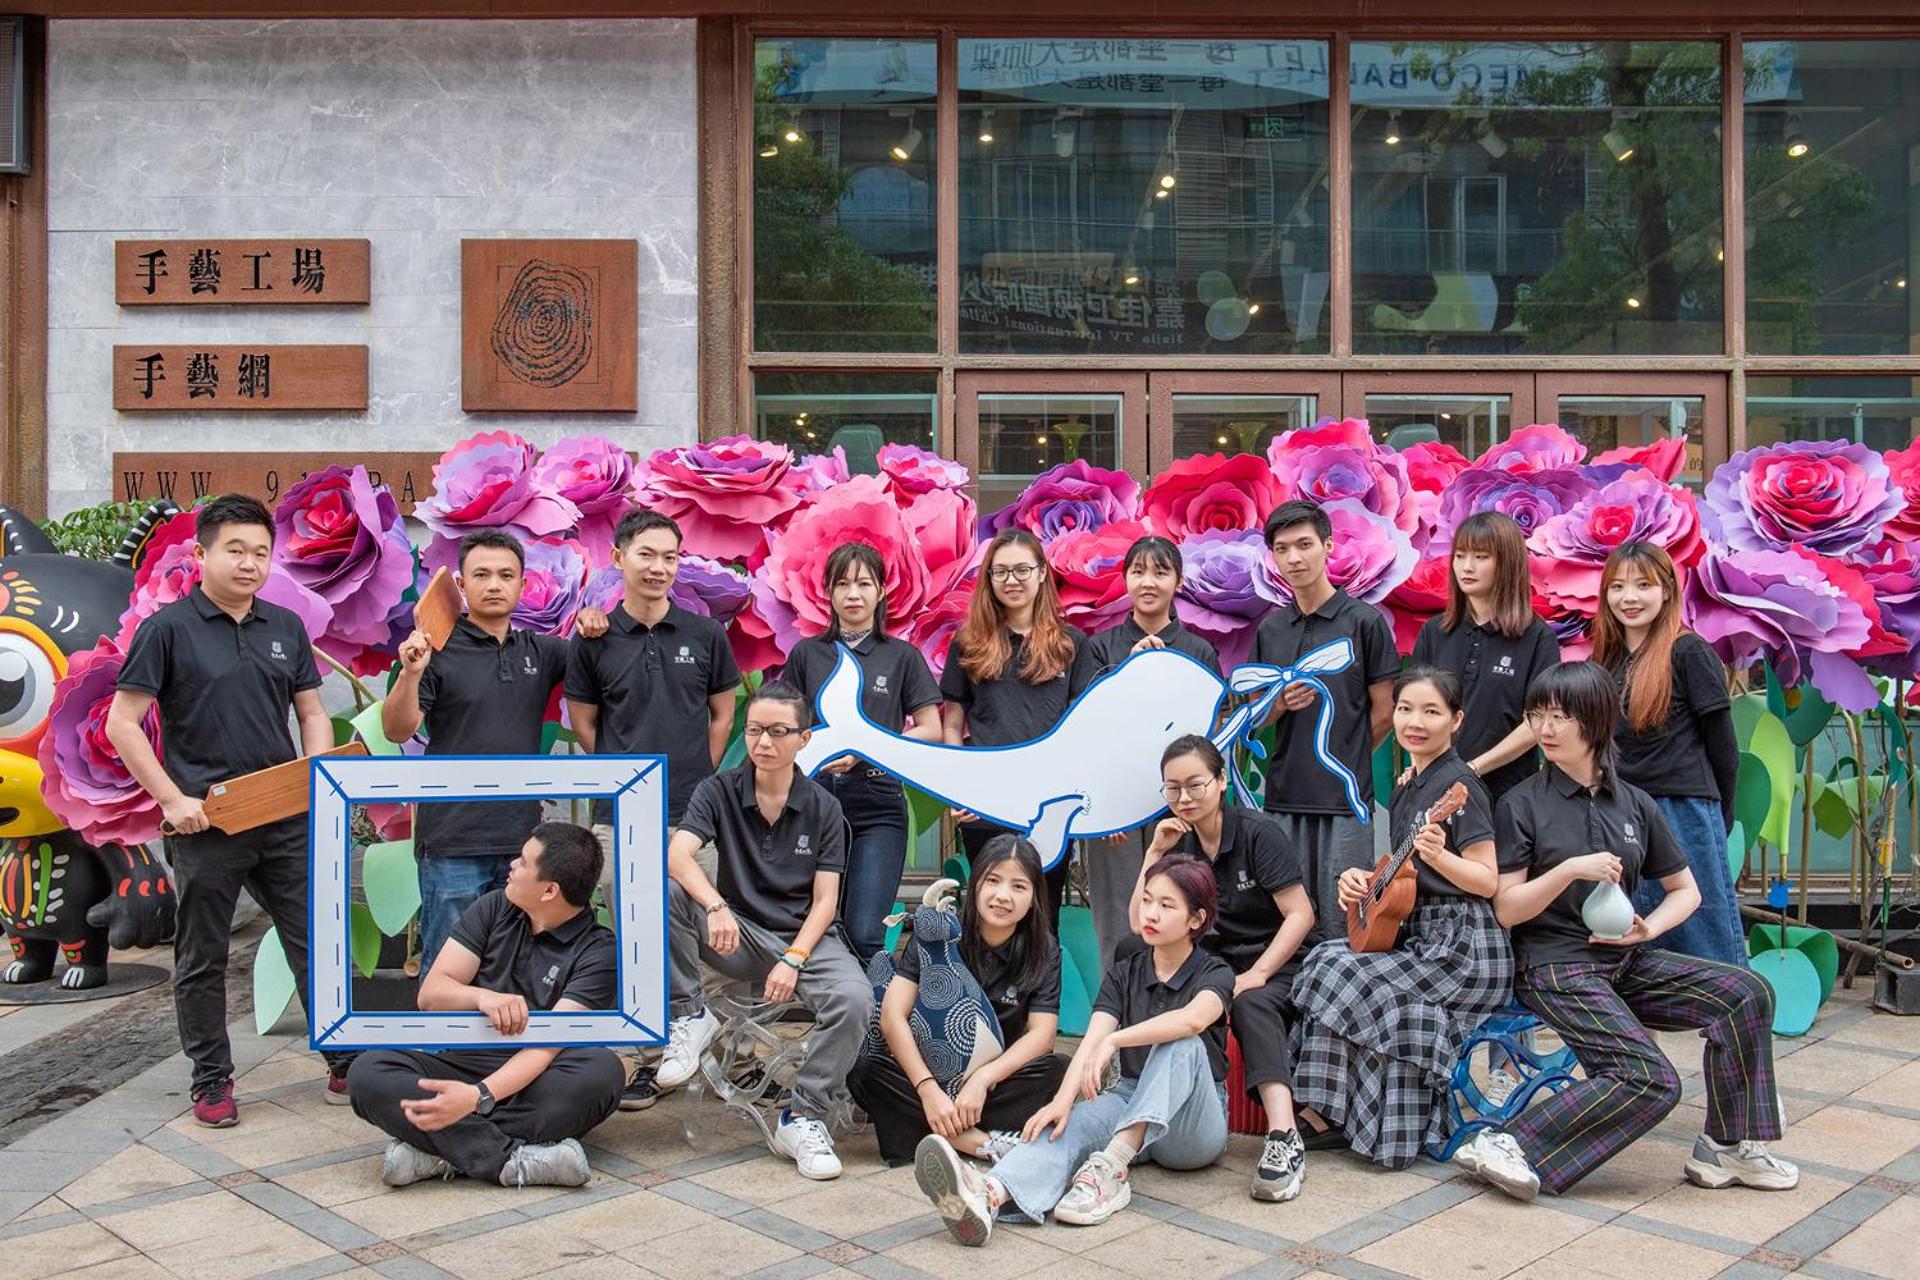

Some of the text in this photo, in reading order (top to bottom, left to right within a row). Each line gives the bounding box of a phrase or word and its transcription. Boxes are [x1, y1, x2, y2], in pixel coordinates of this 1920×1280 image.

[135, 247, 326, 295] 手藝工場
[133, 352, 271, 400] 手藝網
